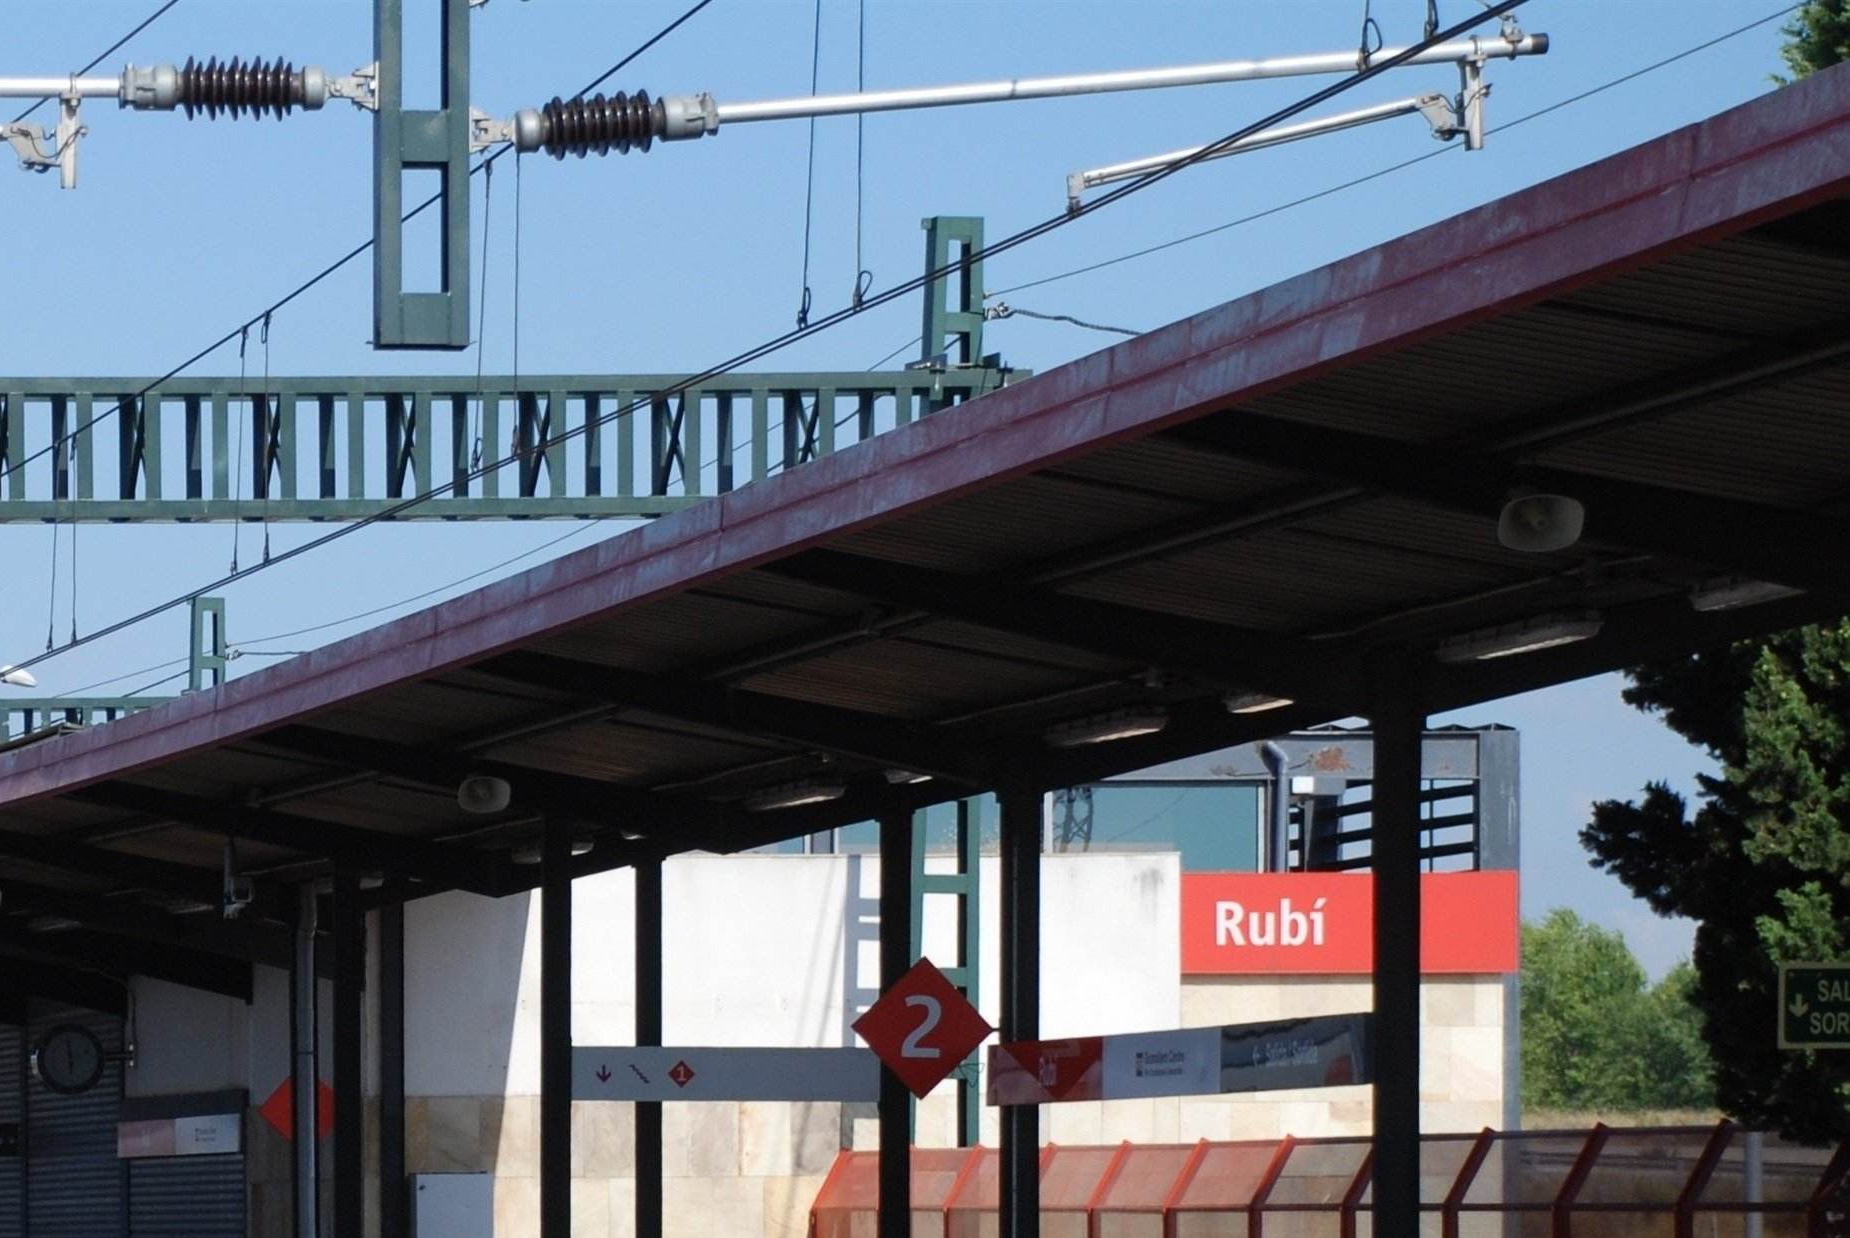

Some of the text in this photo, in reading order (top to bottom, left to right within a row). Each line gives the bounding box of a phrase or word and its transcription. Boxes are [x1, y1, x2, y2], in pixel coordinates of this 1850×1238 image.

[1214, 896, 1327, 947] Rubí
[899, 994, 943, 1059] 2
[677, 1065, 687, 1082] 1
